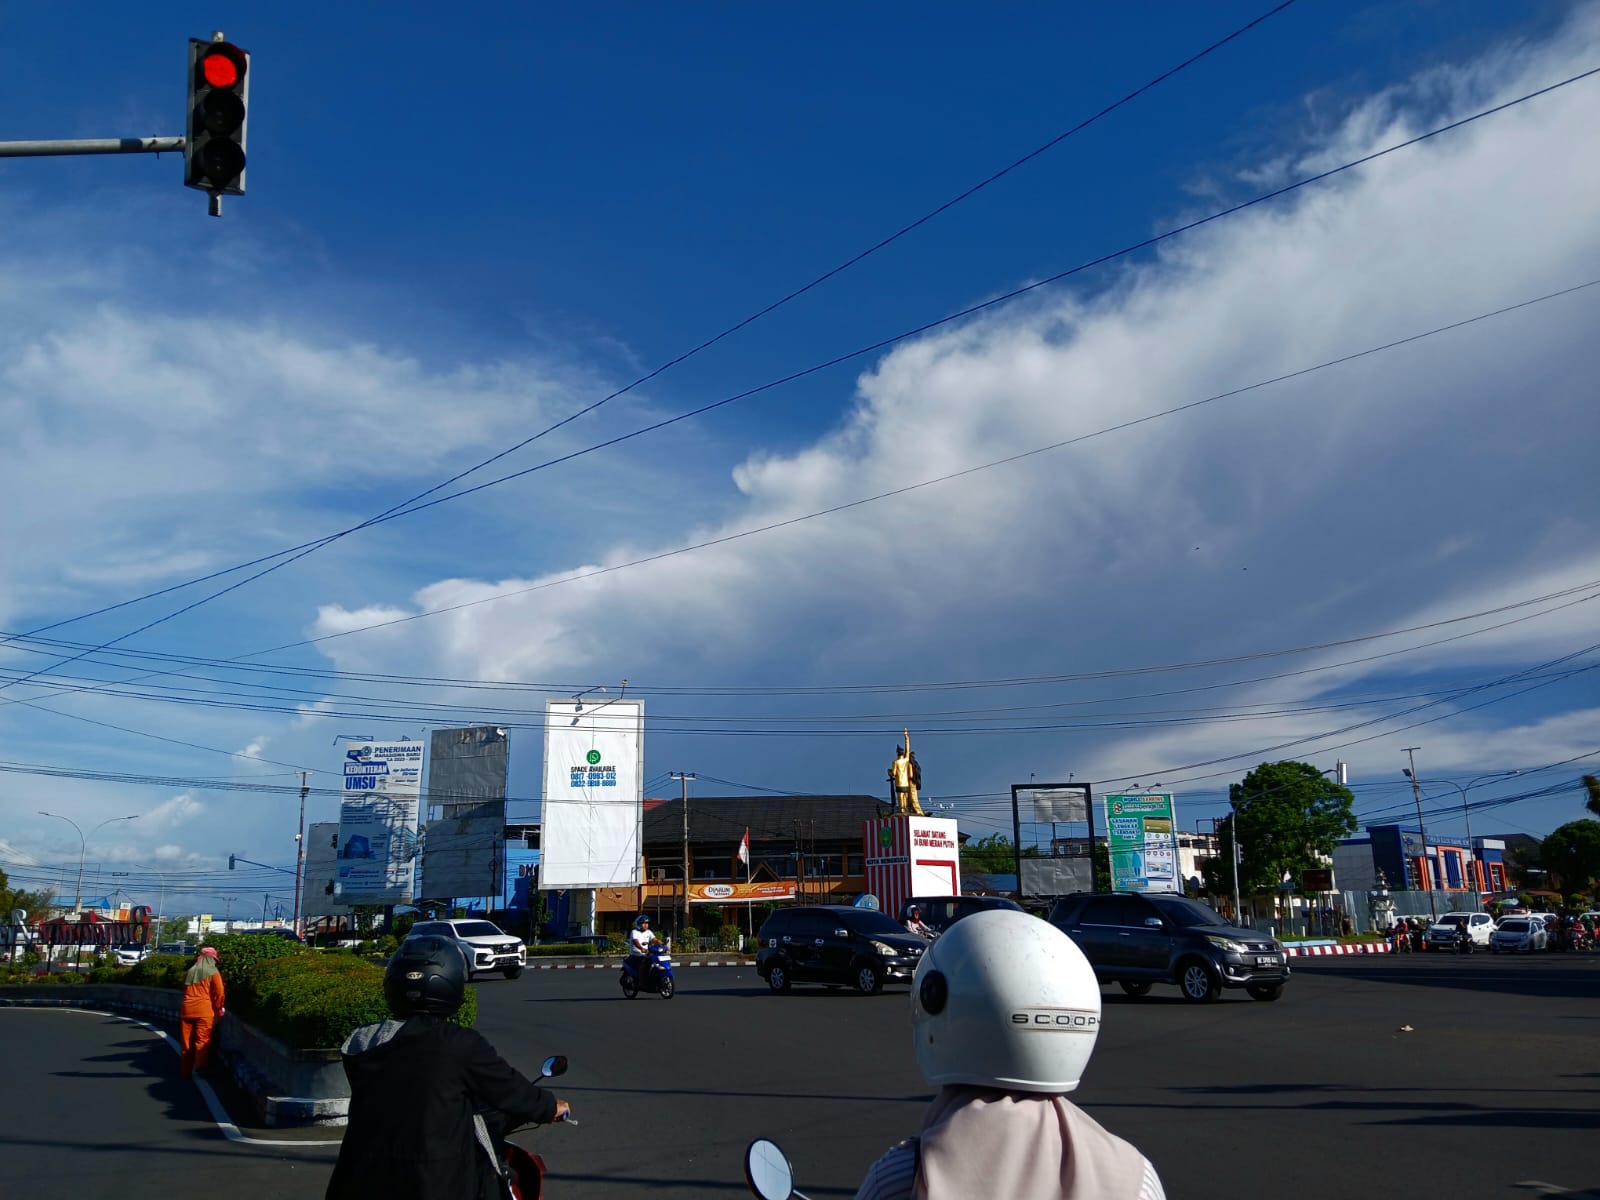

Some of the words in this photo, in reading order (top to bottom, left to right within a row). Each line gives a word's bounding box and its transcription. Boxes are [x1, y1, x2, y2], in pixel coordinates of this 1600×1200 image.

[345, 765, 387, 774] KEDOKTERAN
[345, 776, 376, 790] UMSU
[914, 830, 930, 838] SELAMAT
[932, 830, 946, 839] DATANG
[929, 839, 942, 847] MERAH
[943, 840, 955, 848] PUTIH
